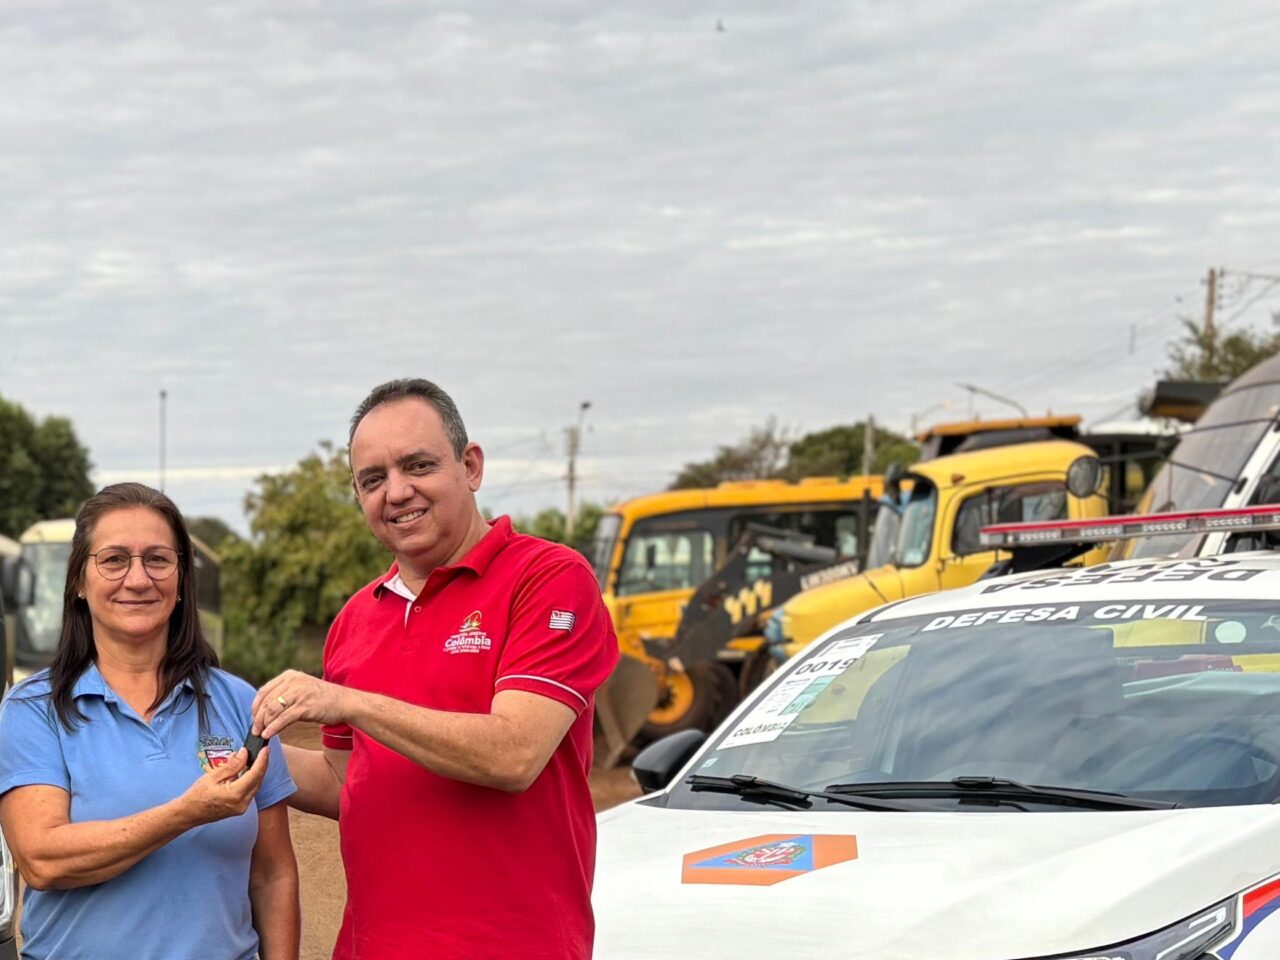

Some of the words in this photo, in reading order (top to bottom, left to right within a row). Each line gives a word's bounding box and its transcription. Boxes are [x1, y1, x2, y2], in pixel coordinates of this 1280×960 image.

[979, 568, 1268, 595] DEFESA
[921, 605, 1081, 632] DEFESA
[1093, 604, 1209, 621] CIVIL
